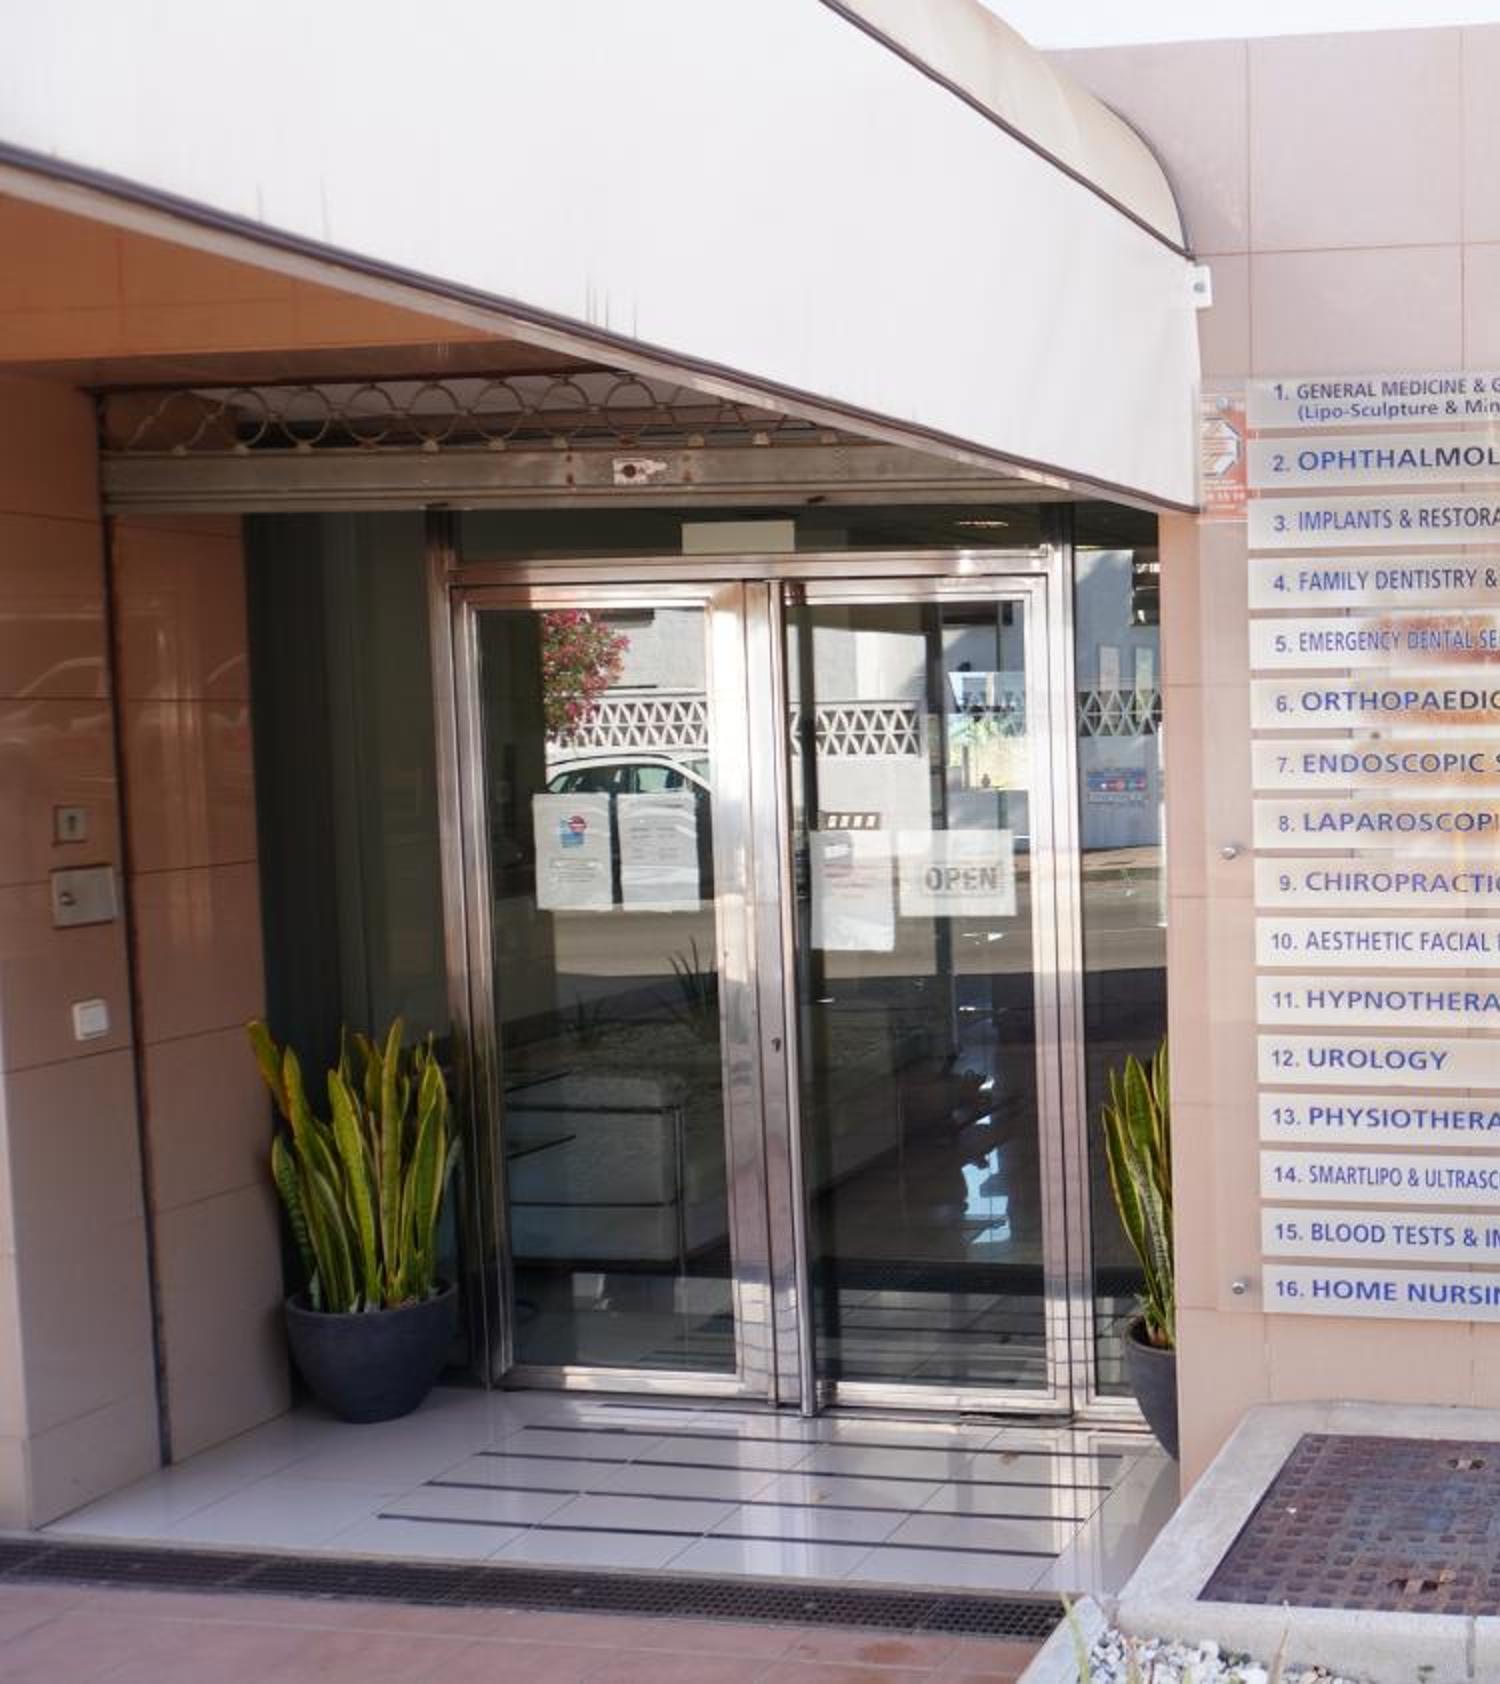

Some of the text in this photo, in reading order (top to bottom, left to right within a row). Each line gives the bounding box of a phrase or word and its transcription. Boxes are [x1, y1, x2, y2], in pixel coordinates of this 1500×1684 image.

[1274, 383, 1289, 401] 1.
[1296, 382, 1377, 401] GENERAL
[1381, 377, 1467, 397] MEDICINE
[1473, 378, 1486, 394] &
[1297, 401, 1439, 422] (Lipo-Sculpture
[1444, 399, 1458, 415] &
[1272, 453, 1291, 473] 2.
[1273, 514, 1290, 533] 3.
[1298, 508, 1393, 532] IMPLANTS
[1398, 508, 1413, 529] &
[1272, 573, 1291, 593] 4.
[1298, 570, 1370, 592] FAMILY
[1374, 568, 1478, 591] DENTISTRY
[1484, 567, 1498, 589] &
[1274, 634, 1293, 653] 5.
[1298, 630, 1401, 653] EMERGENCY
[1407, 629, 1472, 650] DENTAL
[1275, 694, 1294, 713] 6.
[1276, 756, 1295, 774] 7.
[1302, 752, 1486, 774] ENDOSCOPIC
[1277, 814, 1295, 833] 8.
[925, 866, 998, 892] OPEN
[1278, 874, 1297, 892] 9.
[1271, 932, 1298, 951] 10.
[1304, 930, 1414, 952] AESTHETIC
[1419, 931, 1491, 953] FACIAL
[1272, 991, 1300, 1009] 11.
[1271, 1047, 1449, 1071] 12. UROLOGY
[1272, 1106, 1302, 1126] 13.
[1273, 1165, 1303, 1184] 14.
[1308, 1164, 1403, 1188] SMARTLIPO
[1407, 1167, 1420, 1188] &
[1275, 1223, 1304, 1241] 15.
[1310, 1222, 1387, 1244] BLOOD
[1391, 1224, 1456, 1247] TESTS
[1462, 1227, 1480, 1248] &
[1275, 1279, 1305, 1298] 16.
[1311, 1279, 1398, 1302] HOME
